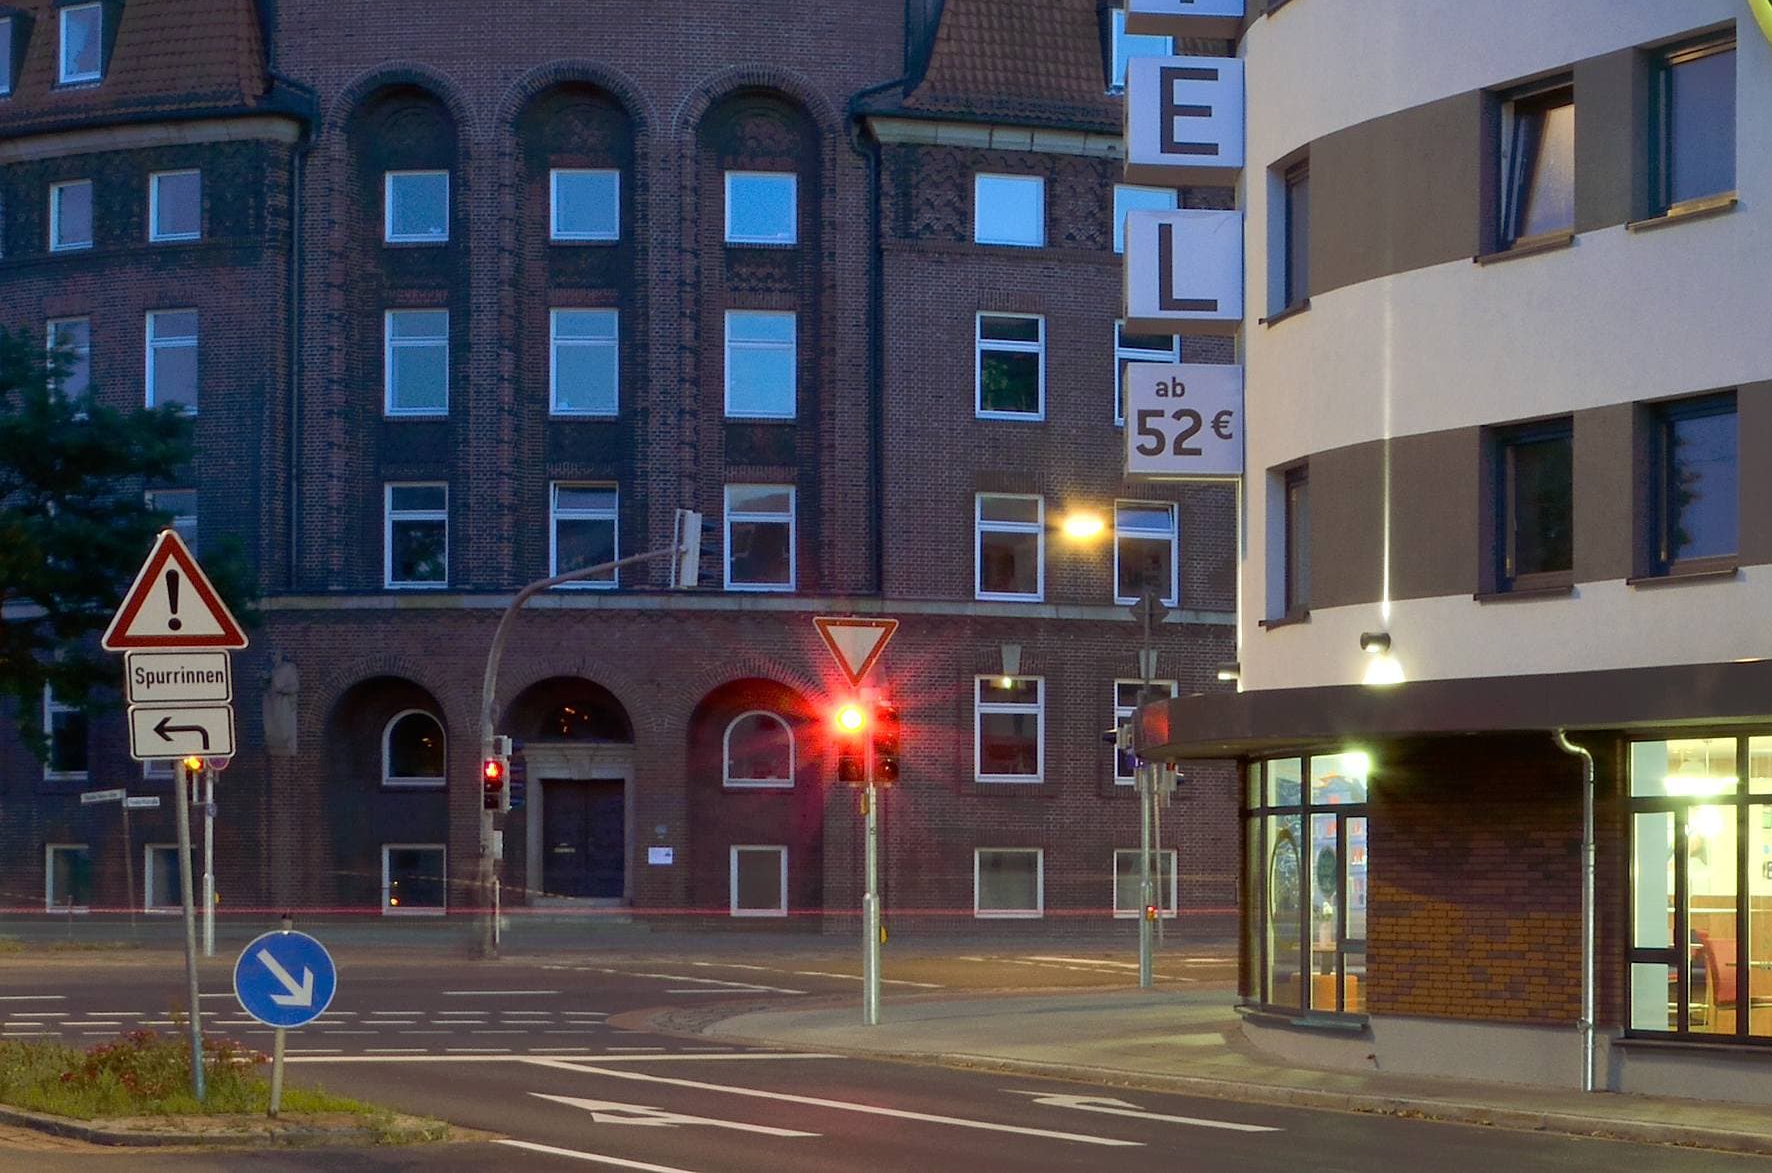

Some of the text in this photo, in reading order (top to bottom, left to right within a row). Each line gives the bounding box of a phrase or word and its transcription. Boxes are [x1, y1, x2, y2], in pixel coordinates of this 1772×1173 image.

[1154, 376, 1186, 398] ab
[1135, 408, 1234, 458] 52€
[134, 666, 225, 690] Spurrinnen
